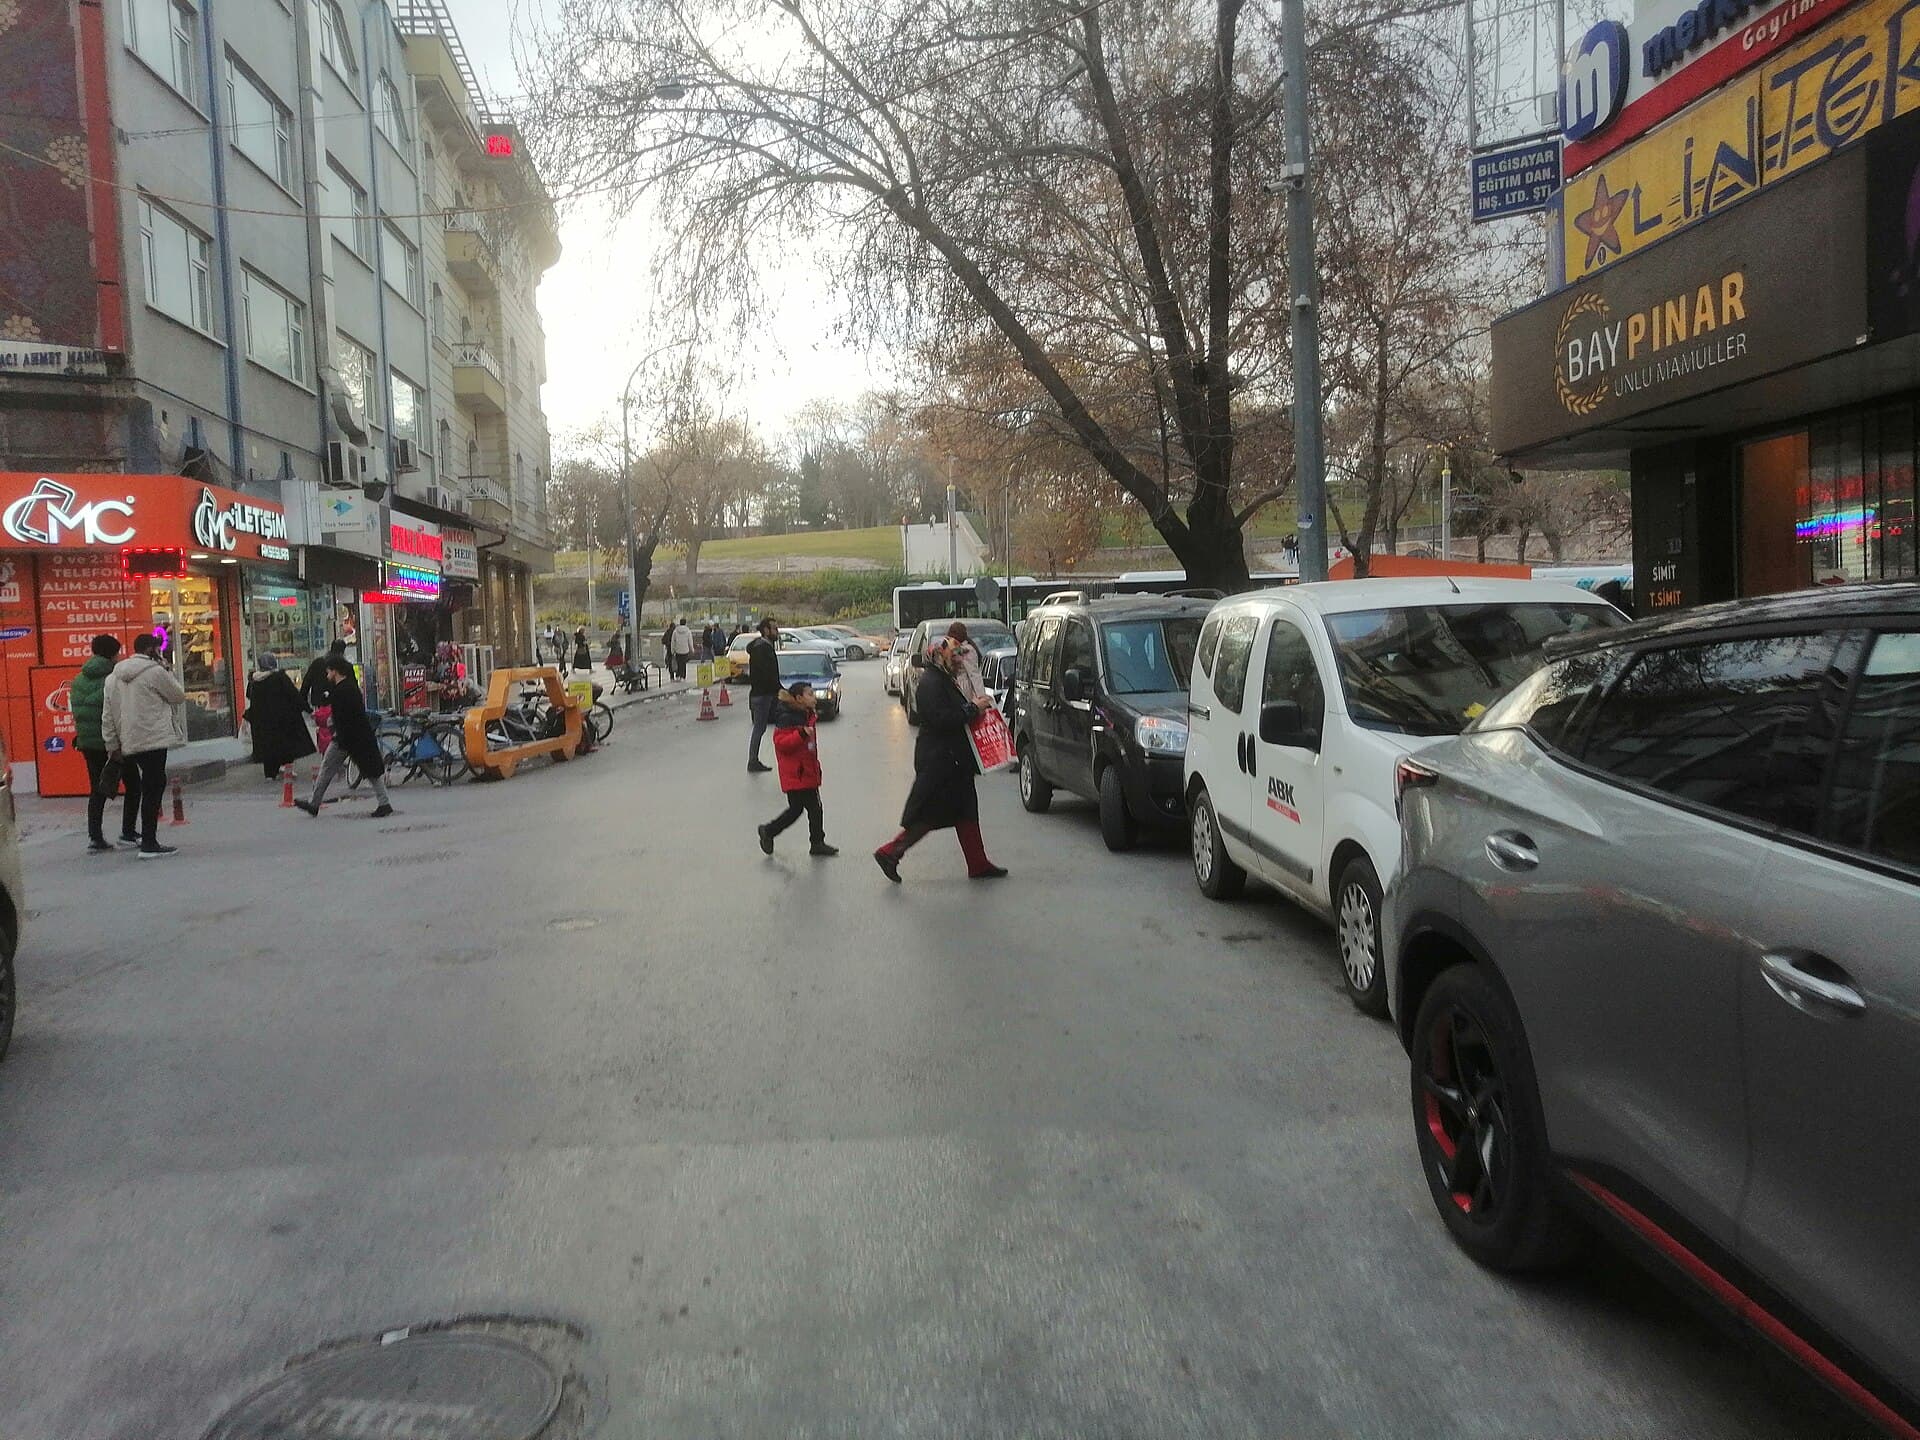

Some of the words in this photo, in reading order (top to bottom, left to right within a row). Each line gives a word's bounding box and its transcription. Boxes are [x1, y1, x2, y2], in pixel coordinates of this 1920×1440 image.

[1478, 150, 1554, 177] BİLGİSAYAR
[1525, 167, 1555, 184] DAN.
[1505, 190, 1529, 205] LTD.
[52, 568, 122, 578] TELEFON
[1652, 560, 1677, 582] SİMİT
[43, 581, 137, 592] ALIM-SATIM
[46, 599, 79, 611] ACİL
[83, 598, 135, 609] TEKNİK
[67, 612, 117, 624] SERVİS
[1268, 775, 1296, 807] ABK
